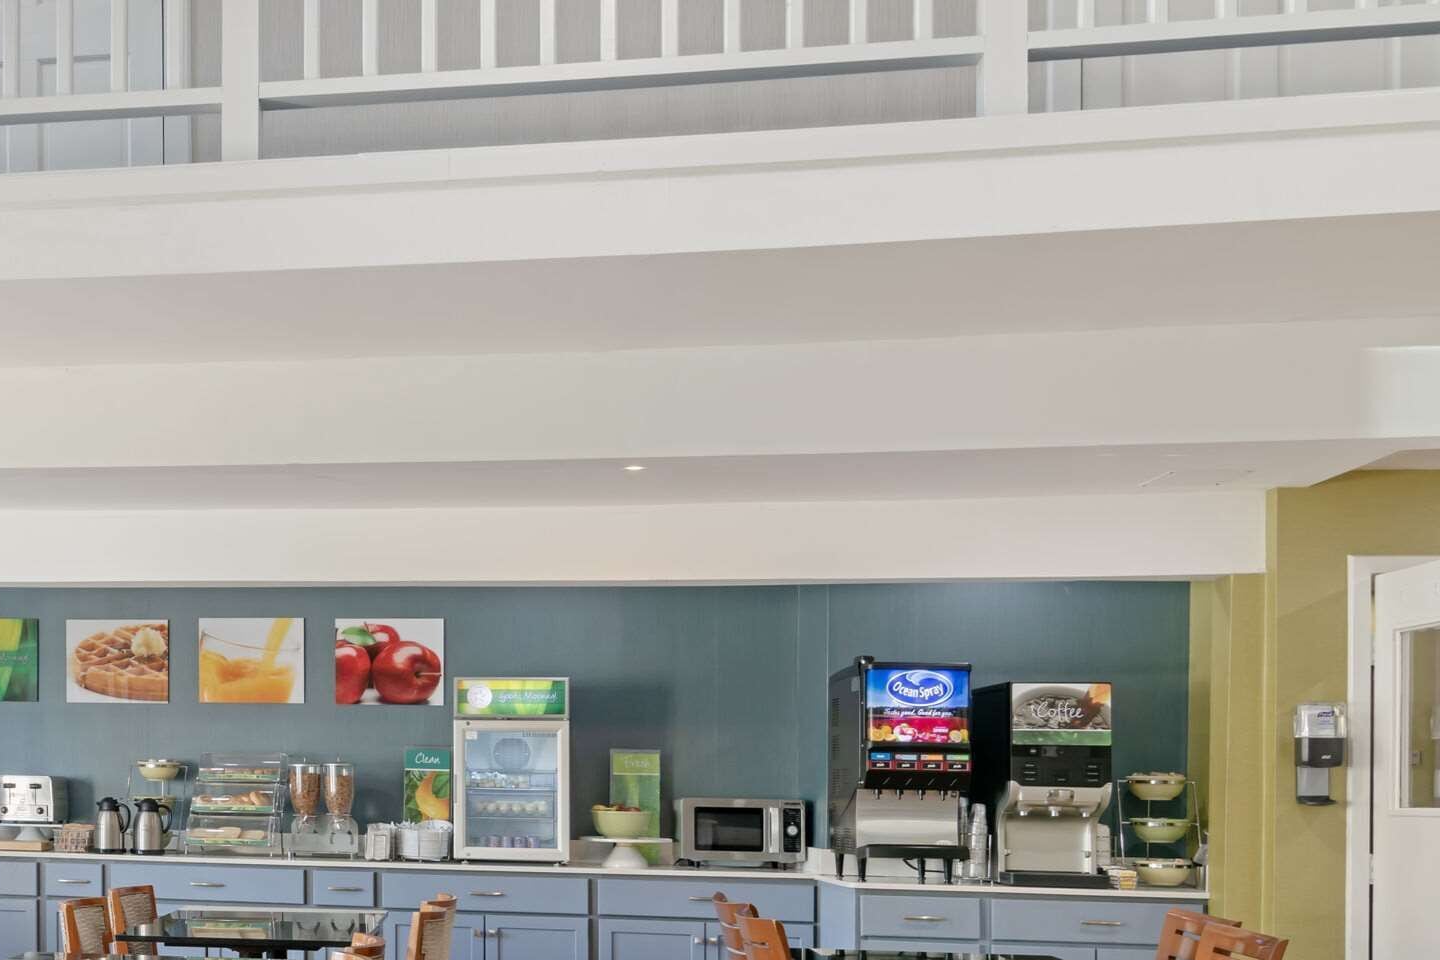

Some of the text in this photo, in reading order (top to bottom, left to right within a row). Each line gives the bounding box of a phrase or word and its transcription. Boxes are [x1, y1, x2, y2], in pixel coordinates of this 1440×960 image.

[892, 681, 944, 700] Ocean Spray
[1036, 701, 1084, 723] Coffee
[415, 751, 441, 764] Clean
